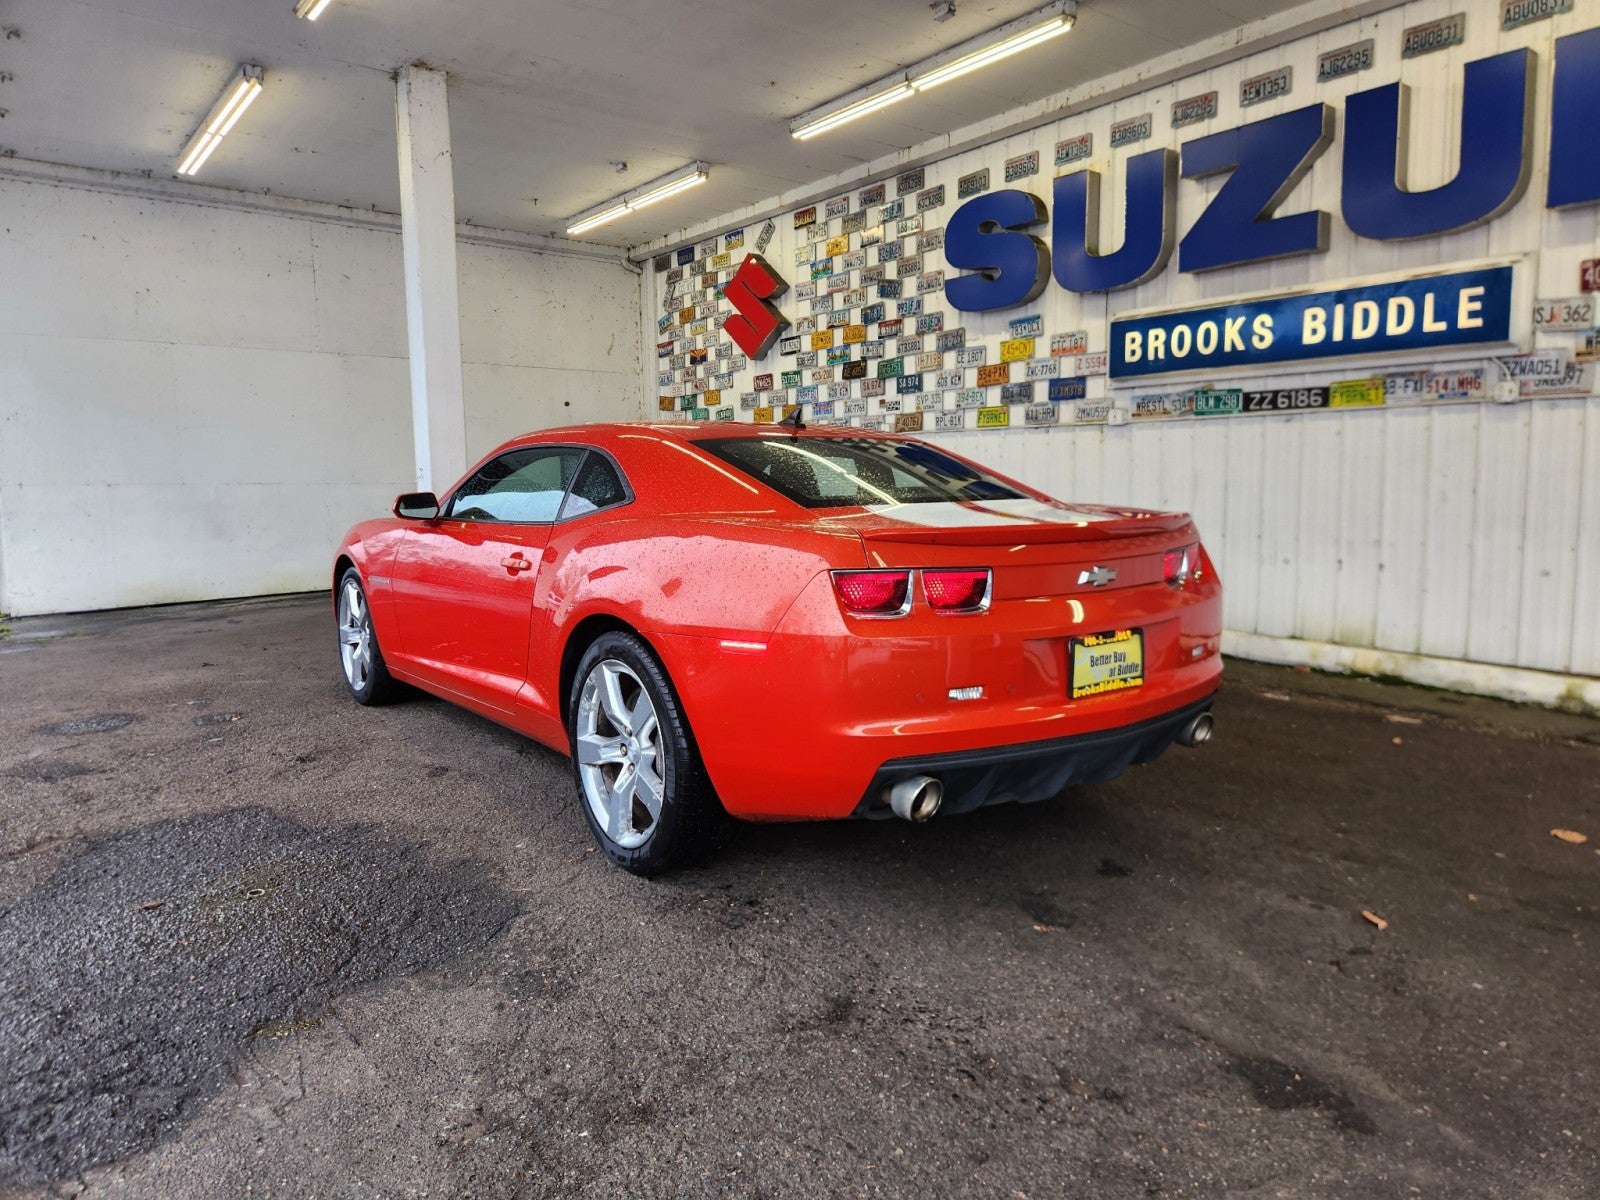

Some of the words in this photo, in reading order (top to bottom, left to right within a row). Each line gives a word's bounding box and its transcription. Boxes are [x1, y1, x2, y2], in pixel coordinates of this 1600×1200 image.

[1404, 23, 1458, 51] ABU0831
[1318, 49, 1369, 78] AJG2295
[1241, 75, 1287, 105] AEW1353
[1563, 304, 1591, 322] 362
[1124, 313, 1274, 364] BROOKS
[1301, 286, 1485, 346] BIDDLE
[1136, 399, 1168, 412] WRESTL
[1248, 393, 1273, 410] ZZ
[1277, 389, 1323, 409] 6186
[1090, 654, 1112, 668] Better
[1113, 651, 1126, 663] Buy
[1117, 663, 1139, 676] Biddle
